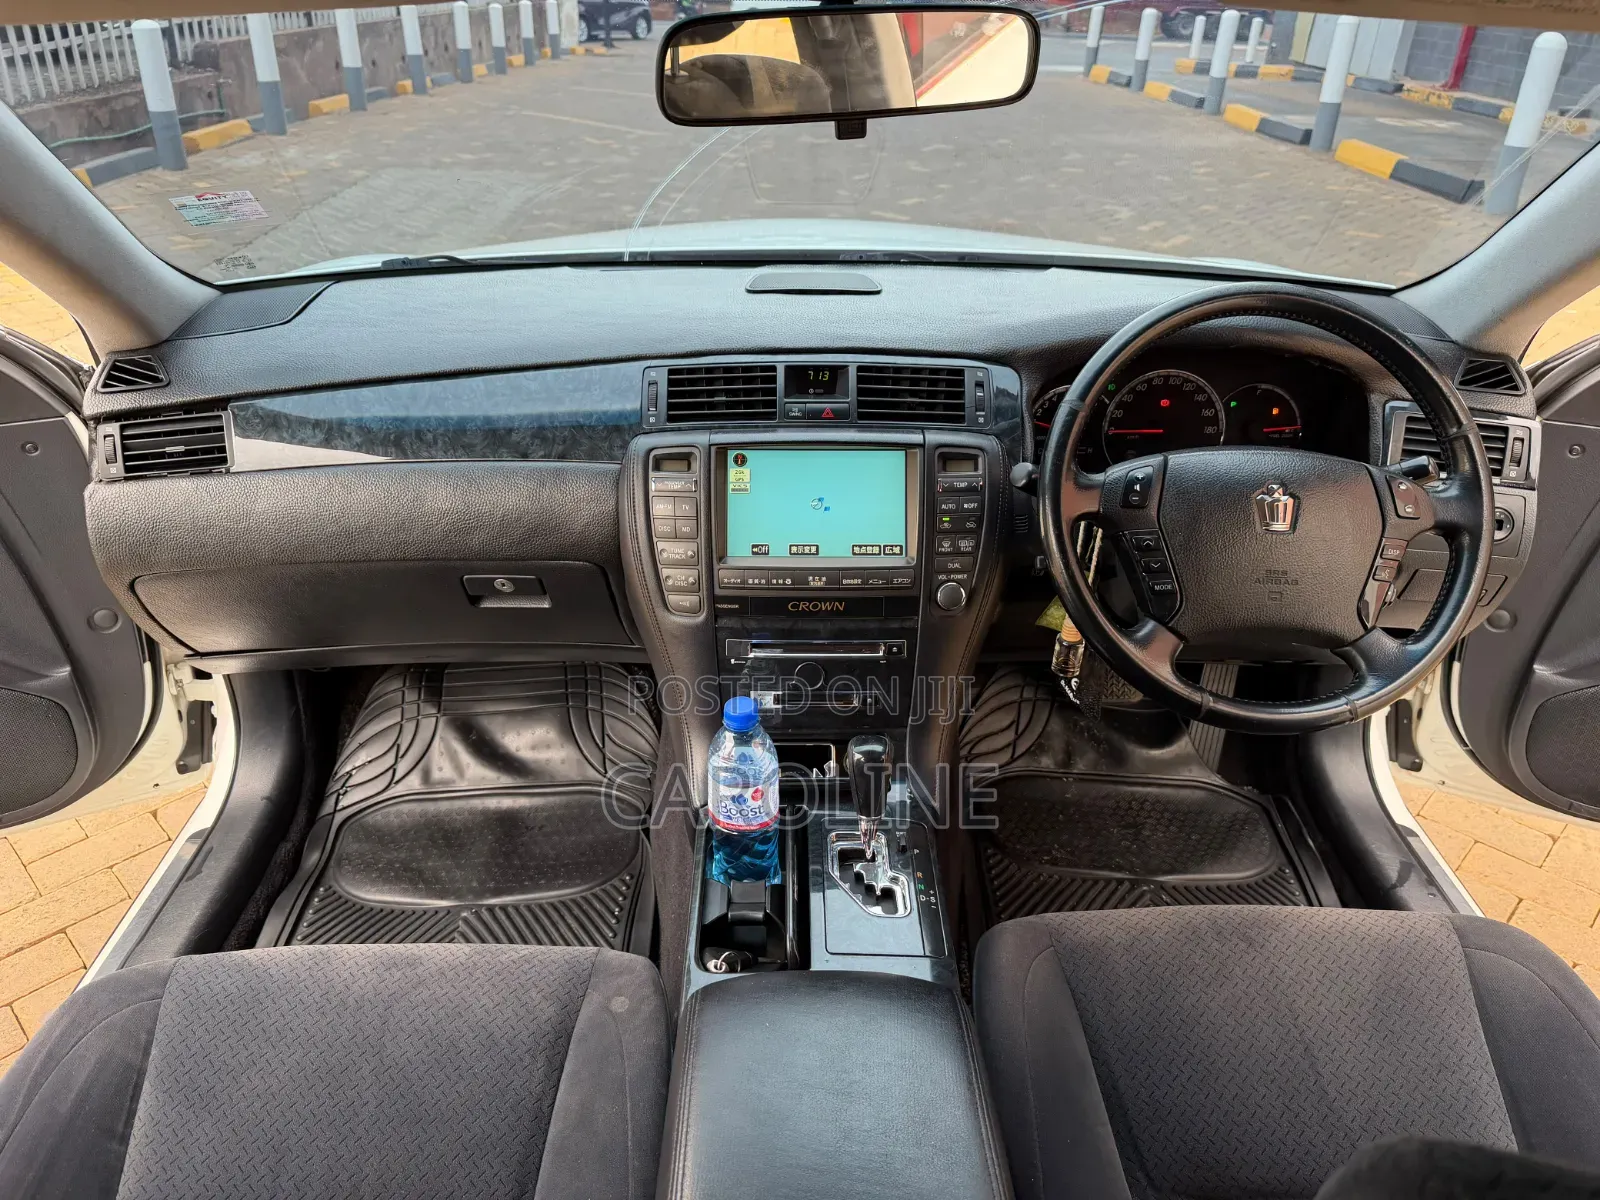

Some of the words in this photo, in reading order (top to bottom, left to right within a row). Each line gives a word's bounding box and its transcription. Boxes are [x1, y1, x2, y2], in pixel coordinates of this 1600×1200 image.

[1152, 377, 1164, 385] 80
[1168, 376, 1183, 385] 100
[1135, 383, 1148, 392] 60
[1182, 382, 1197, 391] 120
[1121, 394, 1134, 402] 40
[1193, 393, 1208, 402] 140
[1111, 409, 1124, 418] 20
[1200, 408, 1215, 417] 160
[1203, 425, 1218, 434] 180
[1154, 583, 1173, 591] MODE
[788, 601, 845, 611] CROWN
[719, 801, 766, 818] Boost
